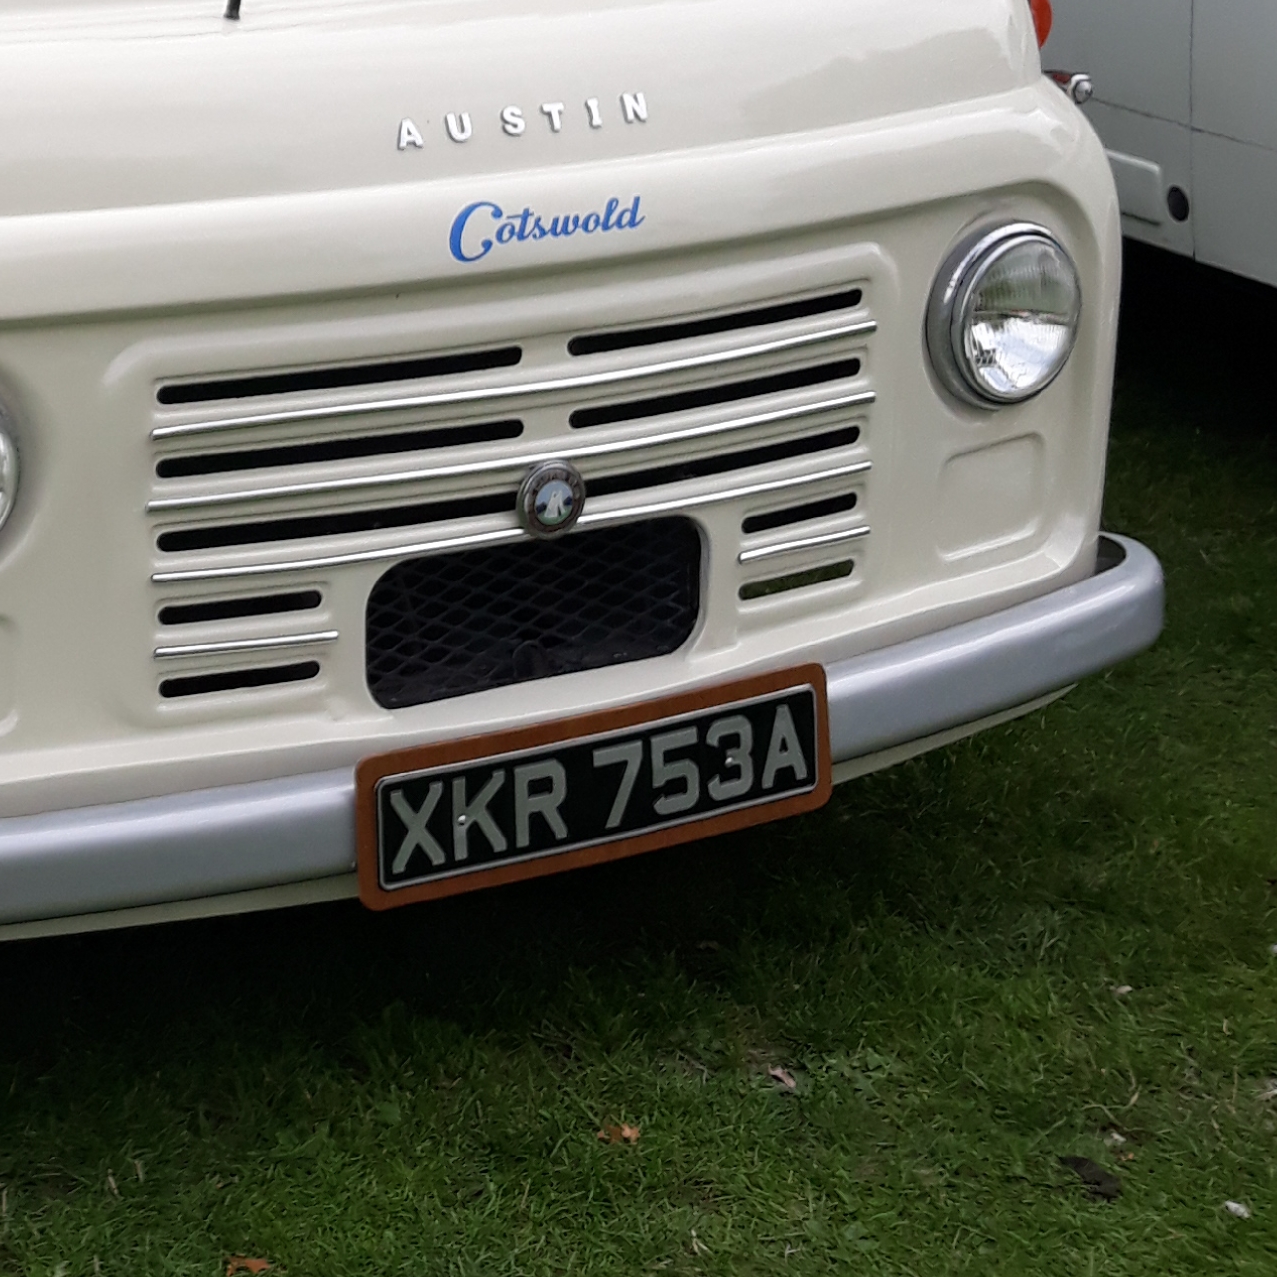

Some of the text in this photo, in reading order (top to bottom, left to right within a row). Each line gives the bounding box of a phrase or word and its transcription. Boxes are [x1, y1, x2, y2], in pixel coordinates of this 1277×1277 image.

[397, 92, 648, 151] AUSTIN
[449, 195, 645, 262] Cotswold
[390, 704, 809, 875] XKR 753A
